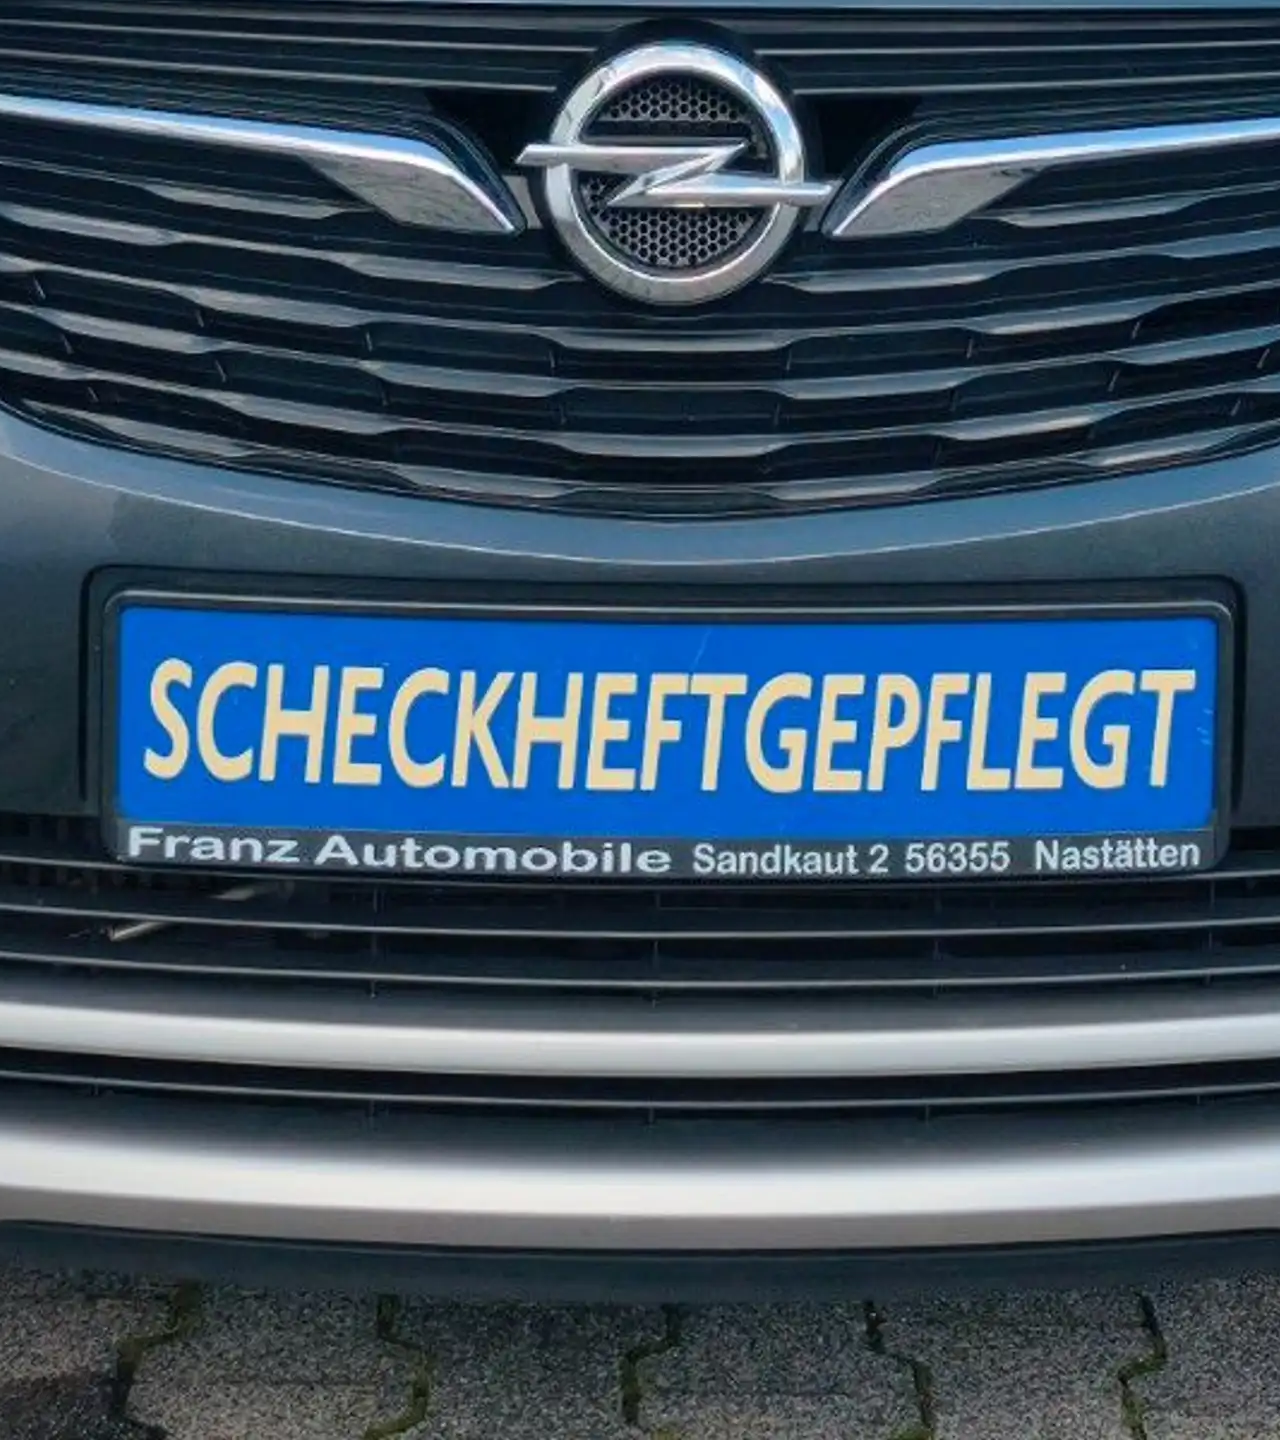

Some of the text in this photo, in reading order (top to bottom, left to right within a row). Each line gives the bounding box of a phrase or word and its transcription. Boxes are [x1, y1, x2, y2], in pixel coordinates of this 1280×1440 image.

[142, 657, 1197, 794] SCHECKHEFTGEPFLEGT
[127, 825, 1202, 876] Franz Automobile Sandkaut 2 56355 Nastätten
